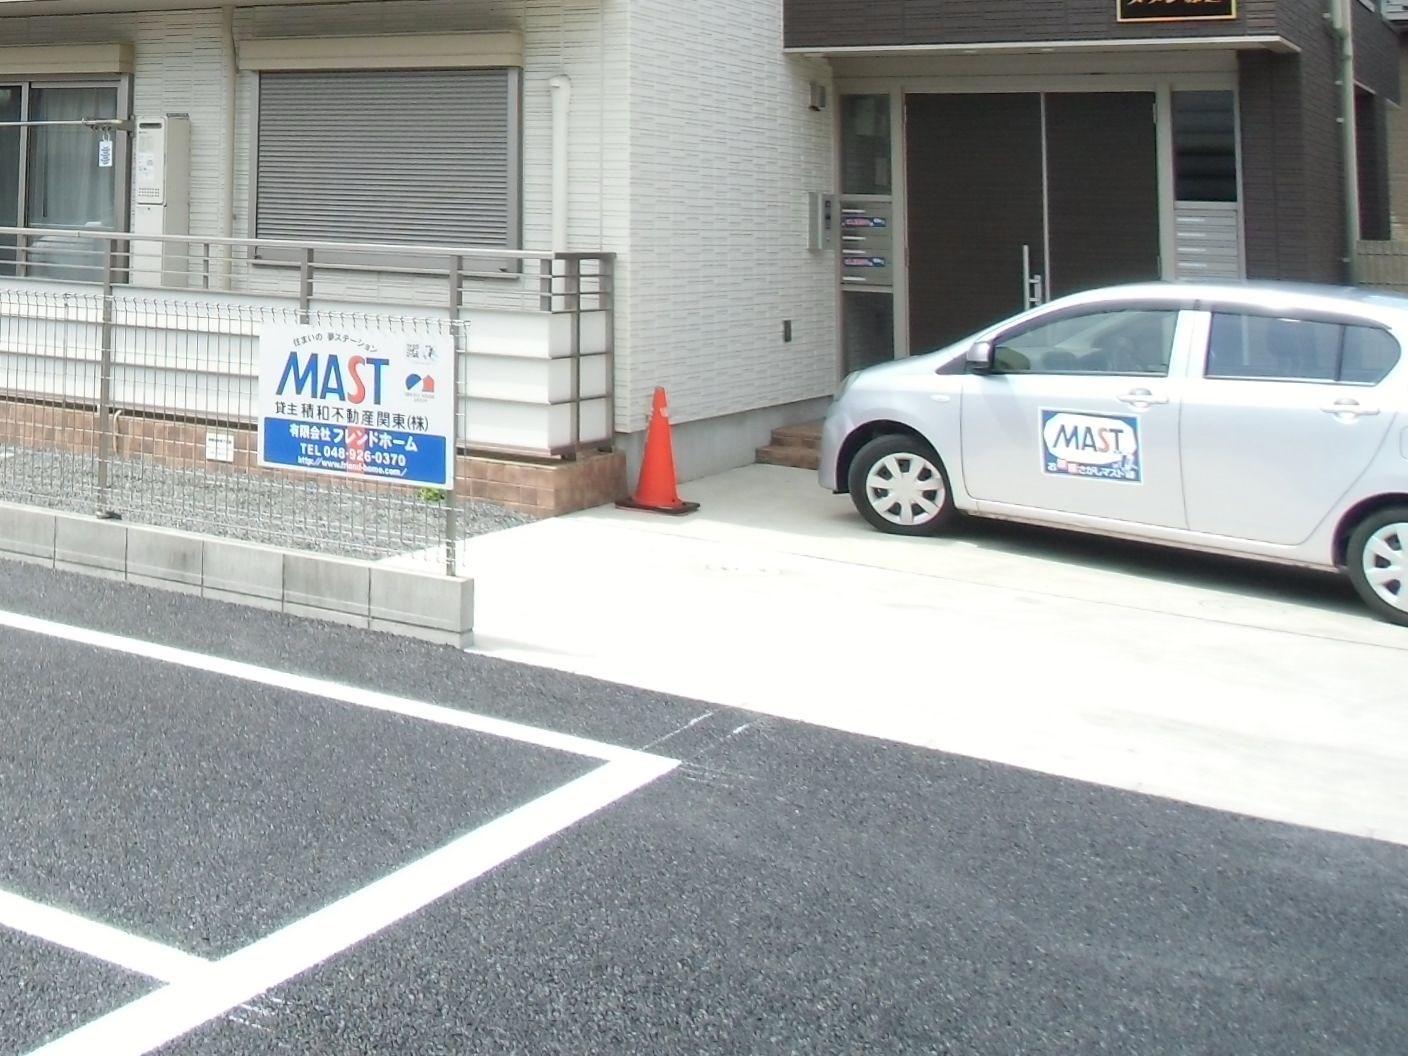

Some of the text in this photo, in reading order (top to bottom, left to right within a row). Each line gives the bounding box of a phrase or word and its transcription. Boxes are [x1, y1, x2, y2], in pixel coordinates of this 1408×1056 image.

[275, 351, 390, 405] MAST
[300, 443, 322, 457] TEL
[1052, 424, 1124, 453] MAST
